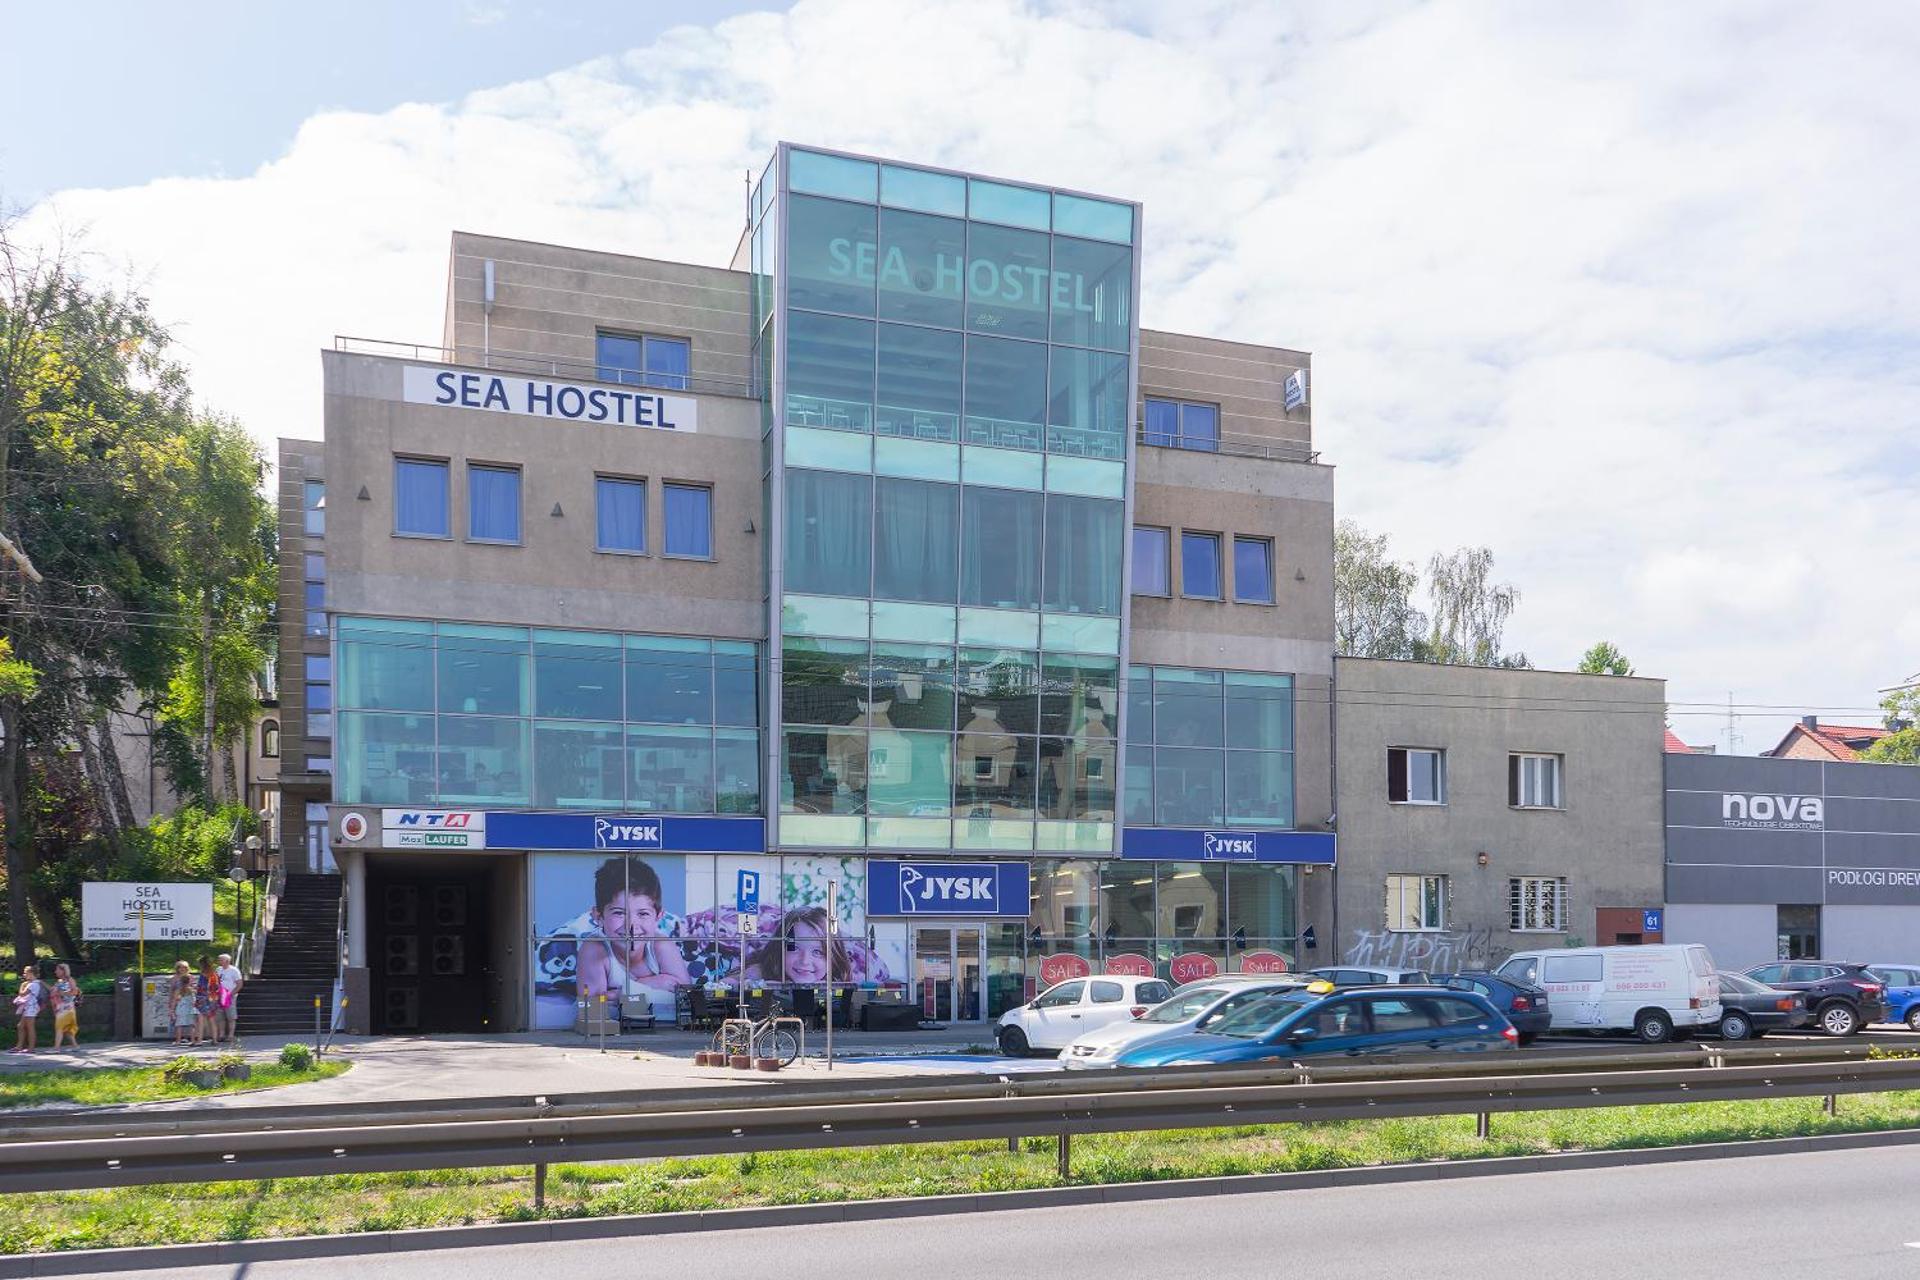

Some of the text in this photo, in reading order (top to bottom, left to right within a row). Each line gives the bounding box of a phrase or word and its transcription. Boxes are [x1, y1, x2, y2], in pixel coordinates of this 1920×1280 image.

[829, 238, 1092, 312] SEA HOSTEL
[436, 372, 675, 429] SEA HOSTEL
[1722, 794, 1824, 821] nova
[400, 813, 471, 828] NTA
[425, 835, 468, 845] LAUFER
[609, 826, 659, 841] JYSK
[1216, 839, 1254, 853] JYSK
[1828, 871, 1885, 886] PODŁOGI
[135, 886, 161, 898] SEA
[742, 873, 756, 901] P
[921, 877, 993, 899] JYSK
[122, 899, 175, 911] HOSTEL
[1647, 916, 1658, 926] 61
[171, 927, 207, 939] piętro
[1048, 964, 1081, 979] SALE
[1179, 962, 1211, 977] SALE
